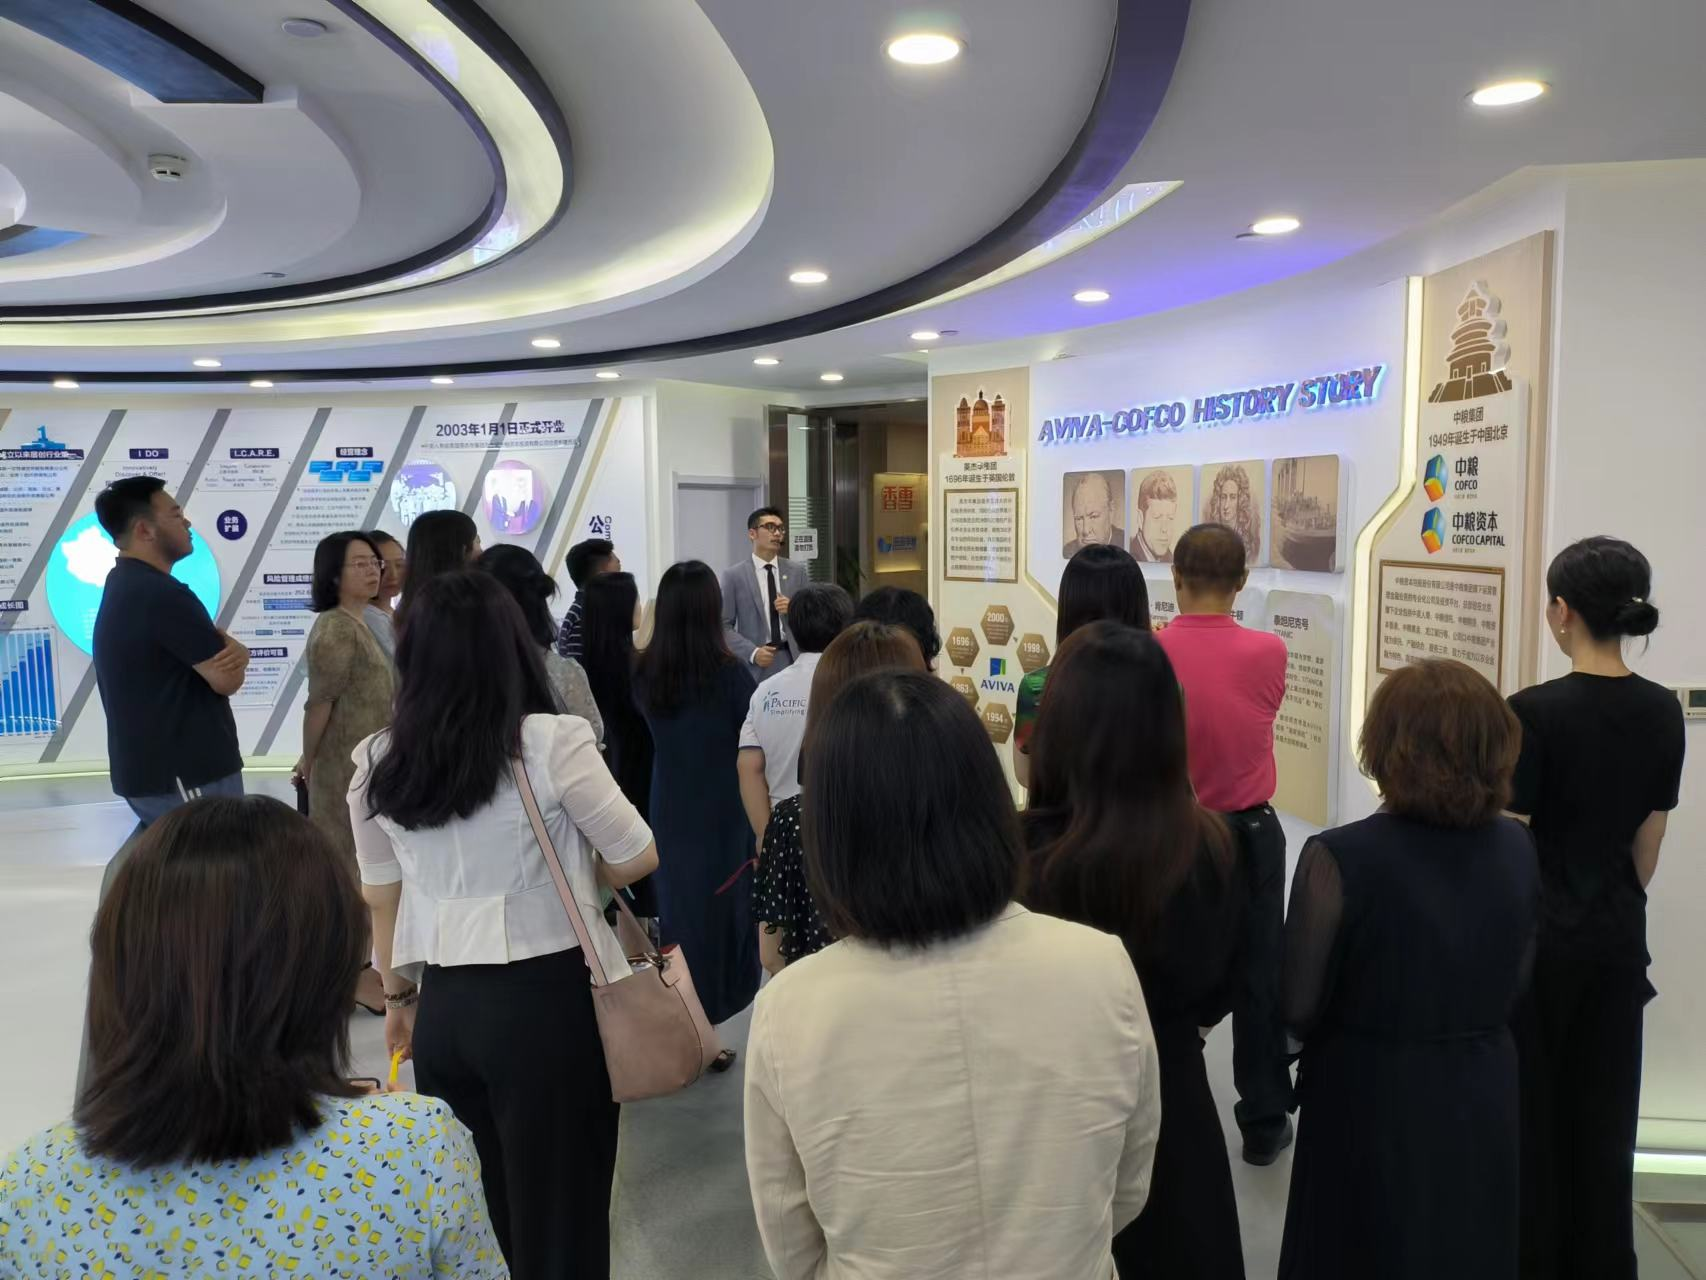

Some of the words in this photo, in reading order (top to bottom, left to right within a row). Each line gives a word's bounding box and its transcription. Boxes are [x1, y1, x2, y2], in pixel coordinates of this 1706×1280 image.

[1038, 404, 1186, 442] AVIVA-COFCO
[1193, 383, 1296, 425] HISTORY
[1299, 366, 1382, 408] STORY
[1453, 406, 1484, 425] 中粮集团
[436, 420, 565, 437] 2003年1月1日正式开业
[1428, 424, 1508, 447] 1949年诞生于中国北京
[1455, 456, 1479, 477] 中粮
[945, 473, 1015, 483] 1696年诞生于英国伦敦
[1455, 480, 1478, 491] COFCO
[1452, 511, 1498, 532] 中粮资本
[1452, 534, 1475, 545] COFCO
[1476, 535, 1505, 547] CAPITAL
[1273, 614, 1309, 631] 泰坦尼克号
[980, 679, 1015, 693] AVIVA
[771, 697, 807, 708] PACIFIC
